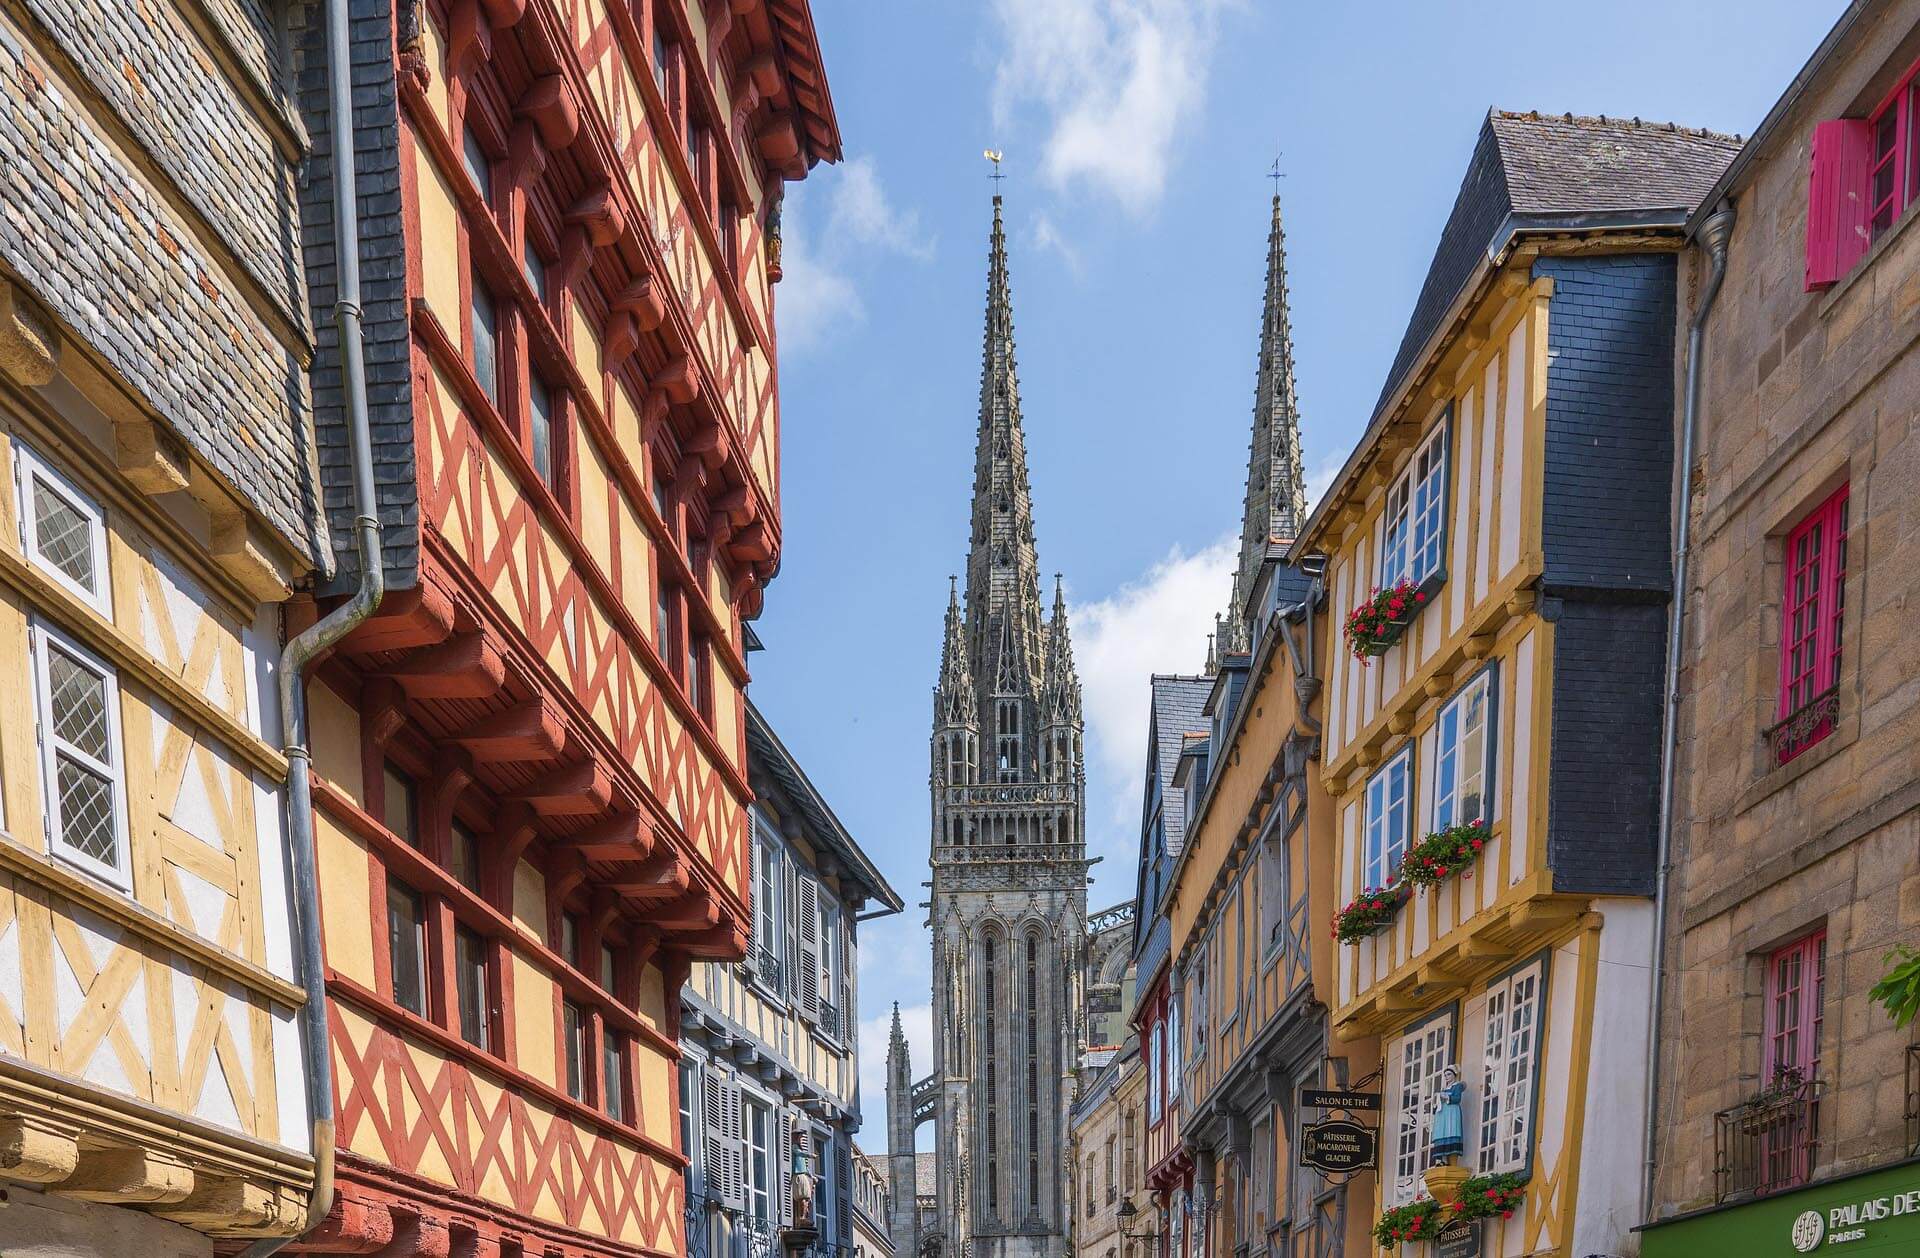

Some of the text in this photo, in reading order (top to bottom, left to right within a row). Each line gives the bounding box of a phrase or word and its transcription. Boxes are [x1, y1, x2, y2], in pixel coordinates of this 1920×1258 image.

[1315, 1096, 1369, 1107] SALON DE THÉ
[1323, 1132, 1356, 1142] PÂTISSERIE
[1317, 1143, 1360, 1153] MACARONERIE
[1325, 1154, 1351, 1162] GLACIER
[1829, 1190, 1920, 1229] PALAIS DE
[1829, 1229, 1866, 1244] PARIS
